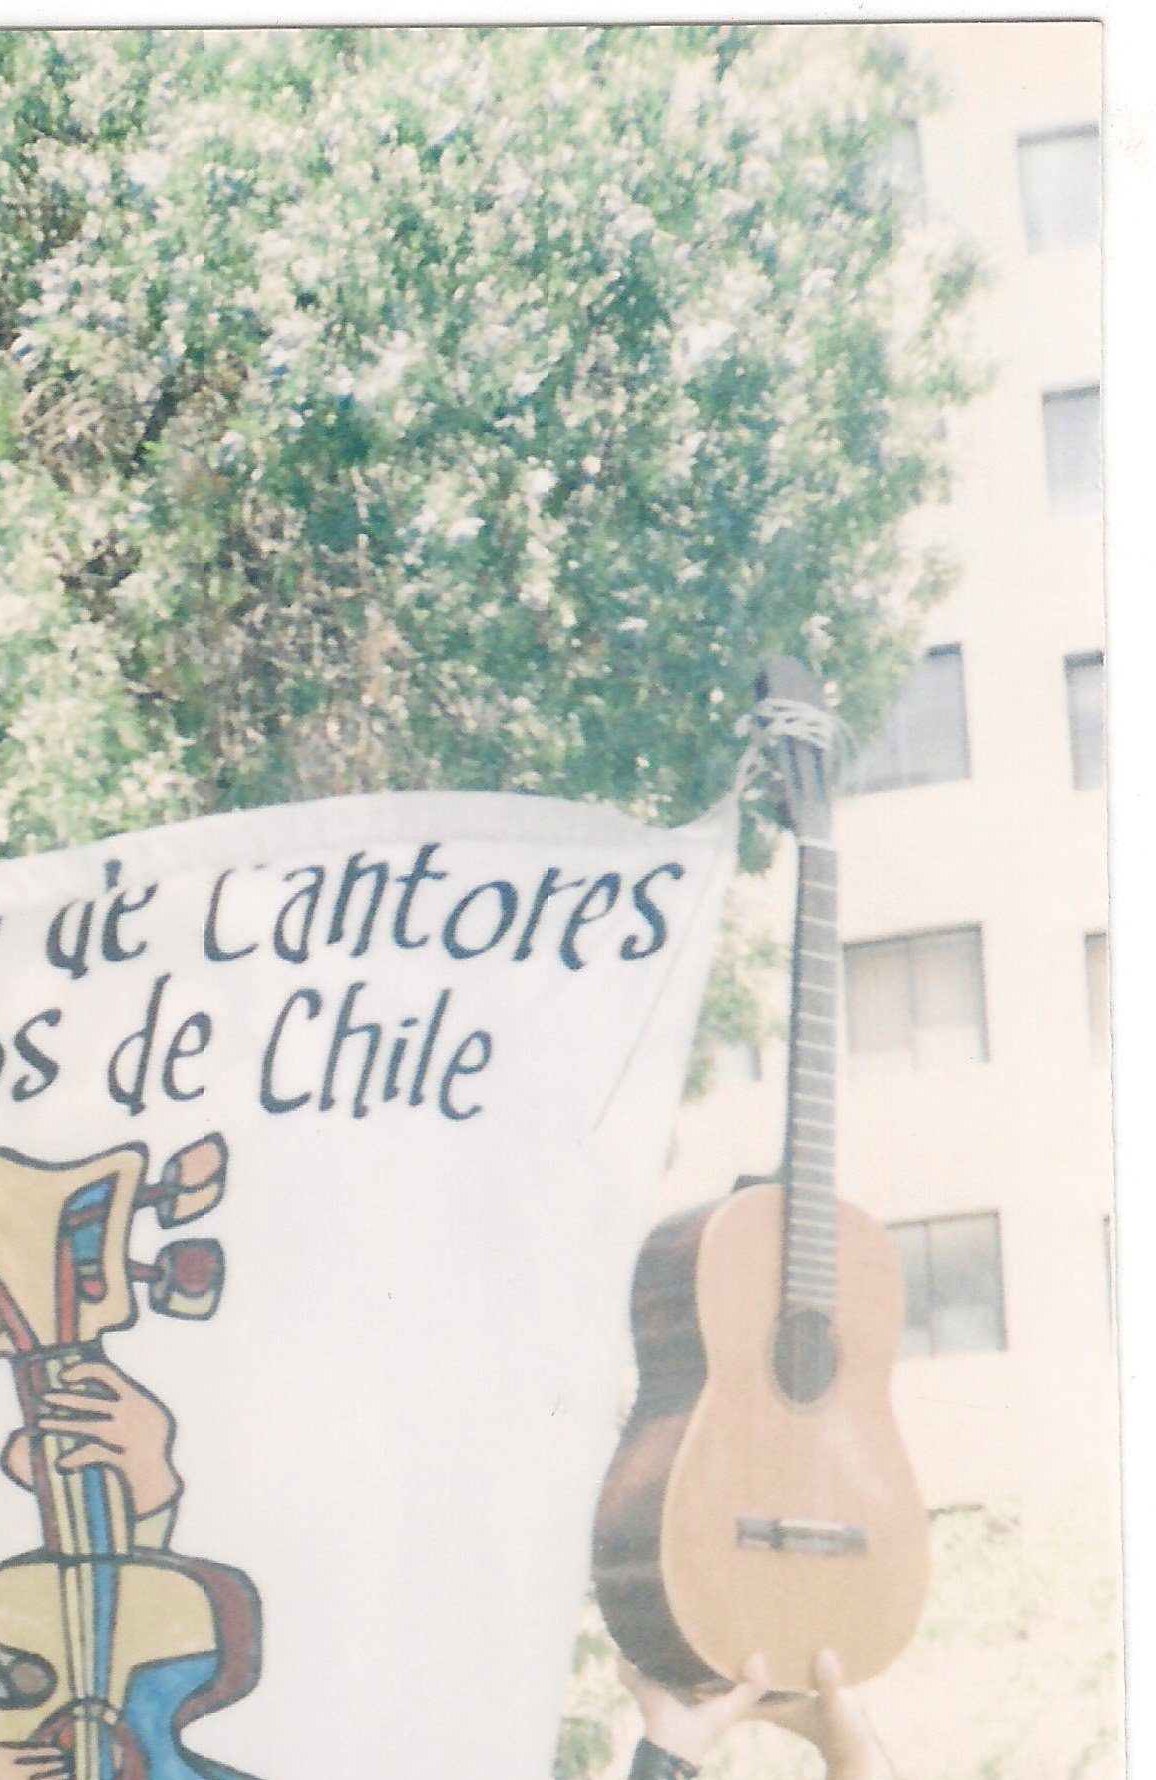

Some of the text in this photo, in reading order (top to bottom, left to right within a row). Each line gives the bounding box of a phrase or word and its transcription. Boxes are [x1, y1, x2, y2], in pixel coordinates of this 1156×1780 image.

[47, 859, 156, 978] de
[204, 843, 685, 971] Cantores
[107, 973, 211, 1115] de
[259, 981, 493, 1121] Chile
